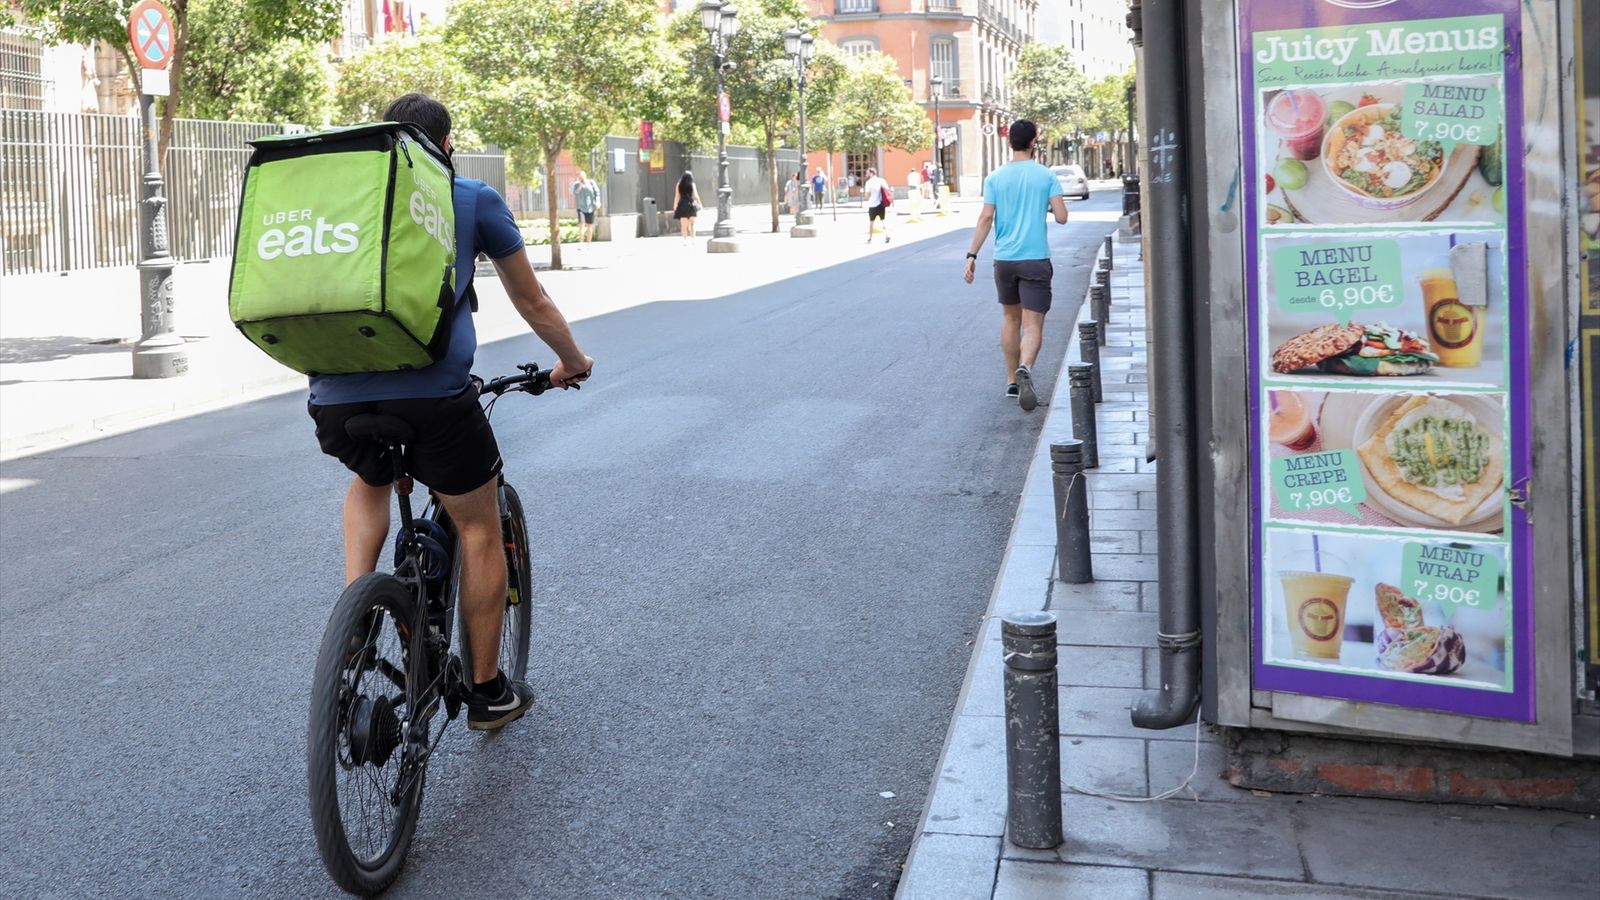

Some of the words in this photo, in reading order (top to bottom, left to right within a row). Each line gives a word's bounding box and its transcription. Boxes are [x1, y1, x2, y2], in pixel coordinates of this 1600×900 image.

[1256, 35, 1359, 65] Juicy
[1365, 26, 1499, 56] Menus
[1422, 84, 1487, 102] MENU
[1413, 100, 1486, 119] SALAD
[1415, 120, 1480, 142] 7,90€
[263, 208, 312, 226] UBER
[409, 191, 454, 255] eats
[257, 216, 360, 260] eats
[1299, 245, 1373, 267] MENU
[1294, 266, 1378, 287] BAGEL
[1319, 284, 1394, 310] 6,90€
[1283, 452, 1343, 472] MENU
[1283, 469, 1347, 488] CREPE
[1290, 487, 1352, 510] 7,90€
[1420, 545, 1485, 568] MENU
[1416, 560, 1480, 584] WRAP
[1414, 580, 1480, 606] 7,90€
